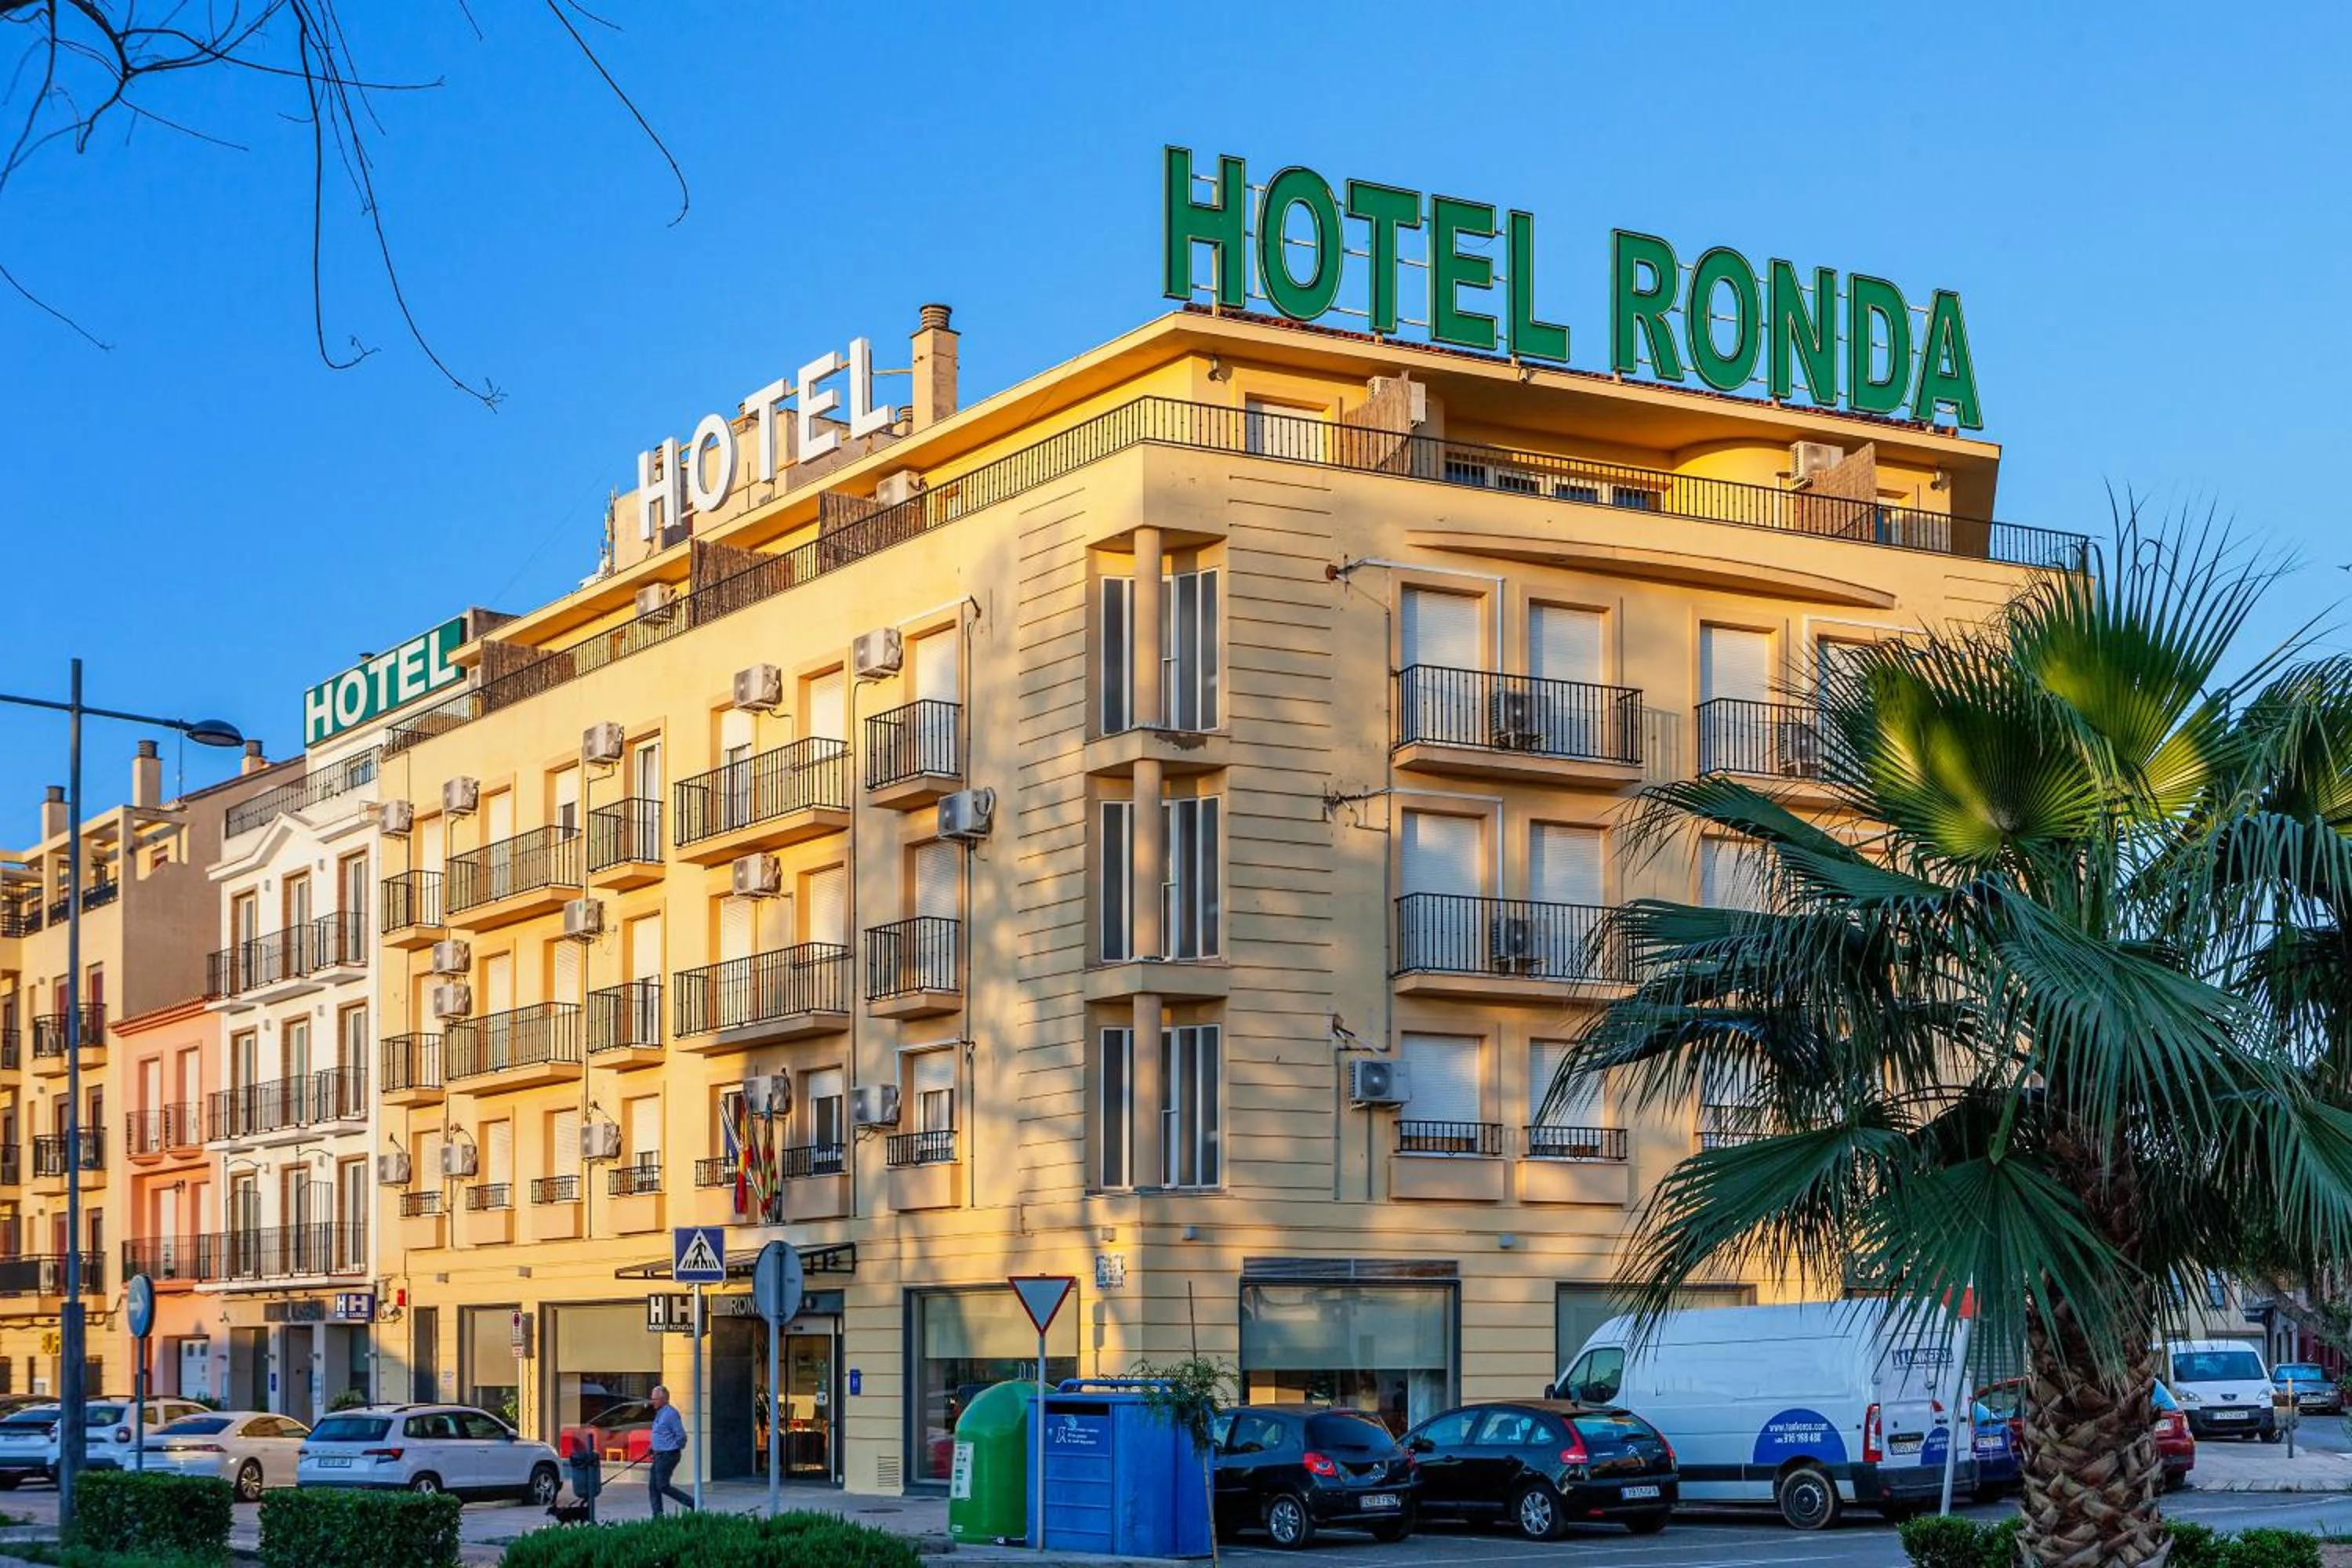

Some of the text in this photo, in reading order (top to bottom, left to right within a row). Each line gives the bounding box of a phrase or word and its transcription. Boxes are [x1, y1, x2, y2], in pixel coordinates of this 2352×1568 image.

[1163, 144, 1984, 430] HOTEL RONDA
[638, 337, 895, 541] HOTEL
[306, 630, 456, 744] HOTEL
[336, 1294, 346, 1312] H
[348, 1294, 368, 1311] H
[649, 1296, 664, 1323] H
[672, 1296, 695, 1323] H
